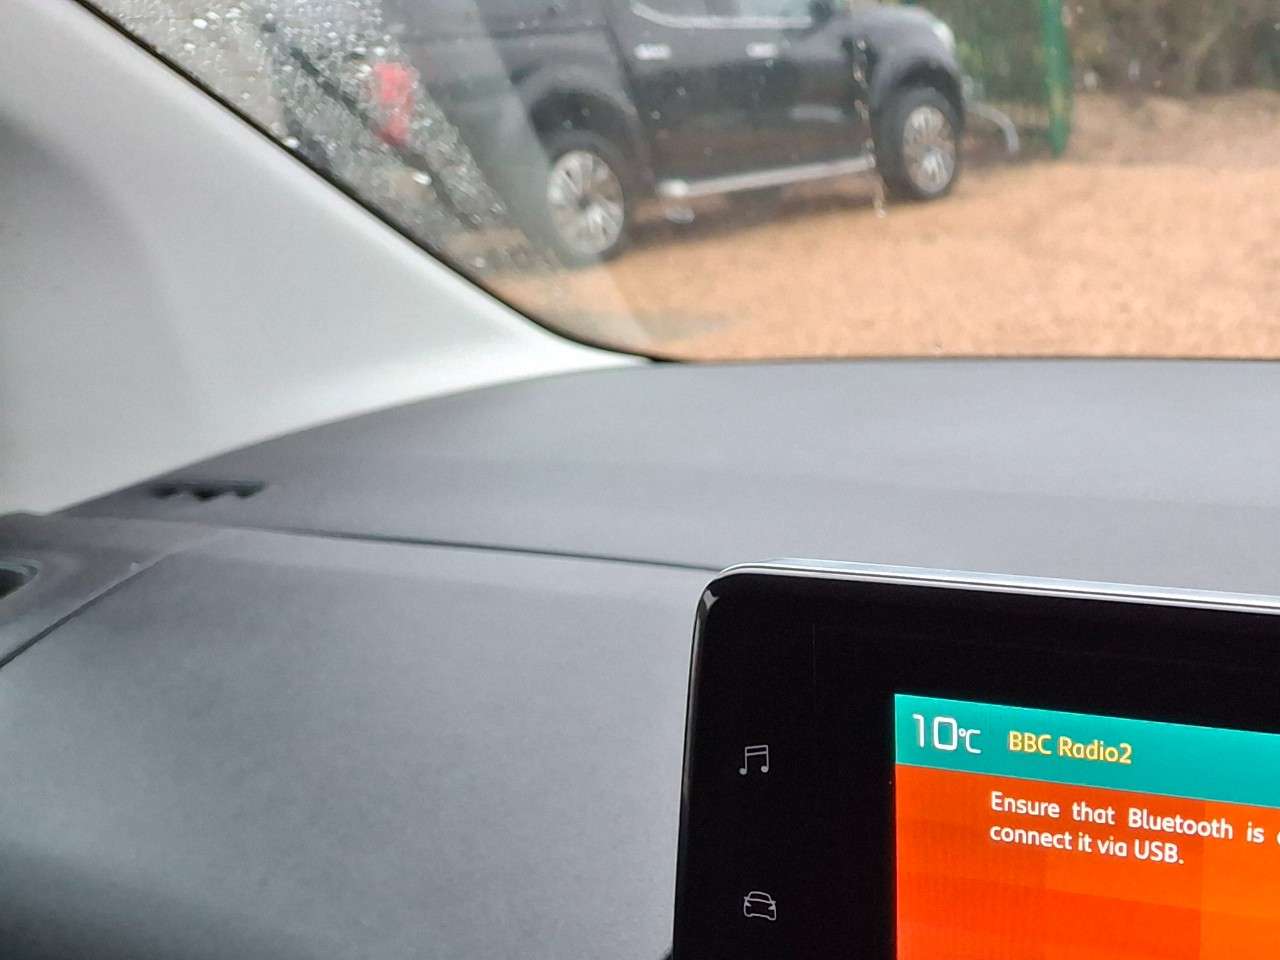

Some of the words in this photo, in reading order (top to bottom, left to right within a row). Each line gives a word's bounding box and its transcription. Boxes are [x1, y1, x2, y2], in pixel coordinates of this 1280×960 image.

[1009, 731, 1051, 755] BBC
[1059, 736, 1132, 763] Radio2
[991, 792, 1060, 817] Ensure
[1072, 802, 1114, 824] that
[1128, 808, 1232, 839] Bluetooth
[1247, 823, 1264, 843] is
[990, 824, 1072, 851] connect
[1078, 834, 1091, 853] it
[1097, 838, 1127, 857] via
[1134, 841, 1185, 865] USB.
